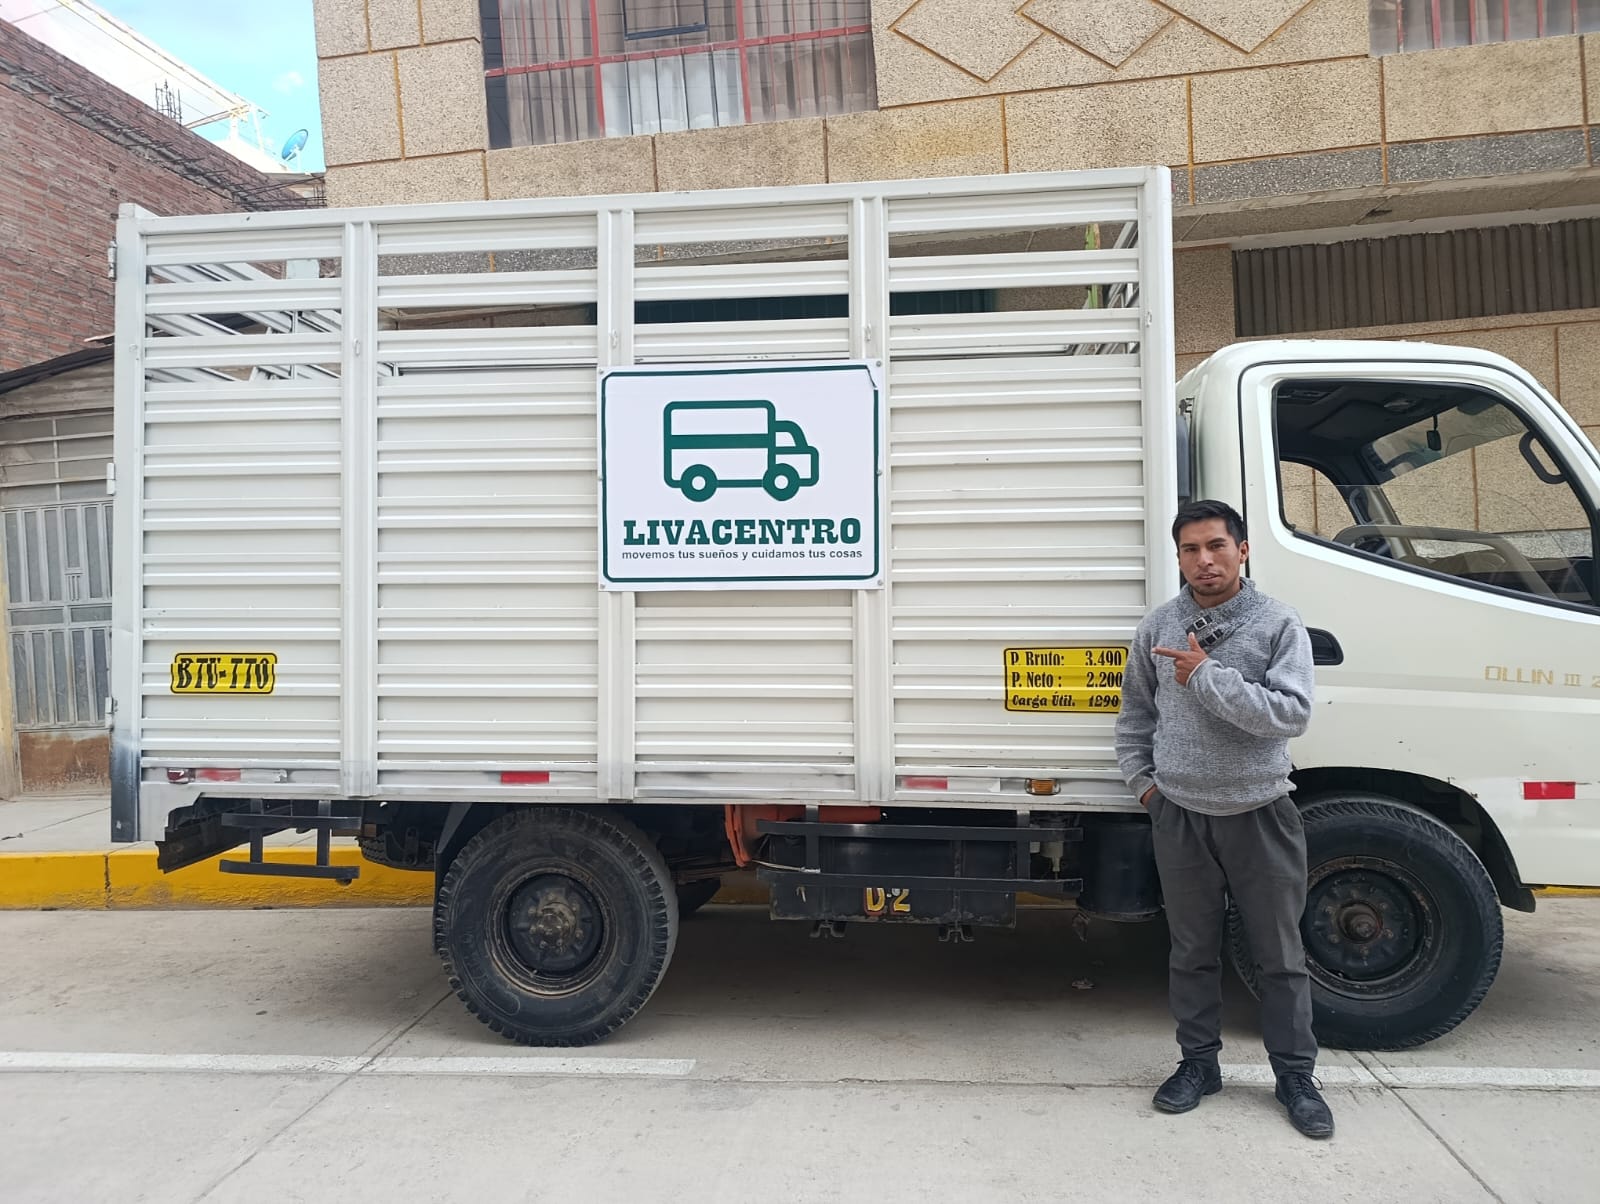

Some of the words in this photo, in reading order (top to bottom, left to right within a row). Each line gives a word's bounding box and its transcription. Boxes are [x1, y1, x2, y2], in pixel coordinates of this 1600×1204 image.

[623, 518, 861, 546] LIVACENTRO
[622, 551, 675, 560] movemos
[678, 550, 695, 559] tus
[699, 549, 739, 559] sueños
[741, 551, 748, 561] y
[751, 549, 805, 559] cuidamos
[808, 549, 826, 559] tus
[829, 549, 863, 559] cosas
[1085, 650, 1122, 666] 3.490
[1011, 671, 1022, 688] P.
[1086, 671, 1123, 688] 2.200
[1485, 665, 1554, 685] OLLIN
[1012, 694, 1047, 708] Carga
[1088, 694, 1120, 707] 1290
